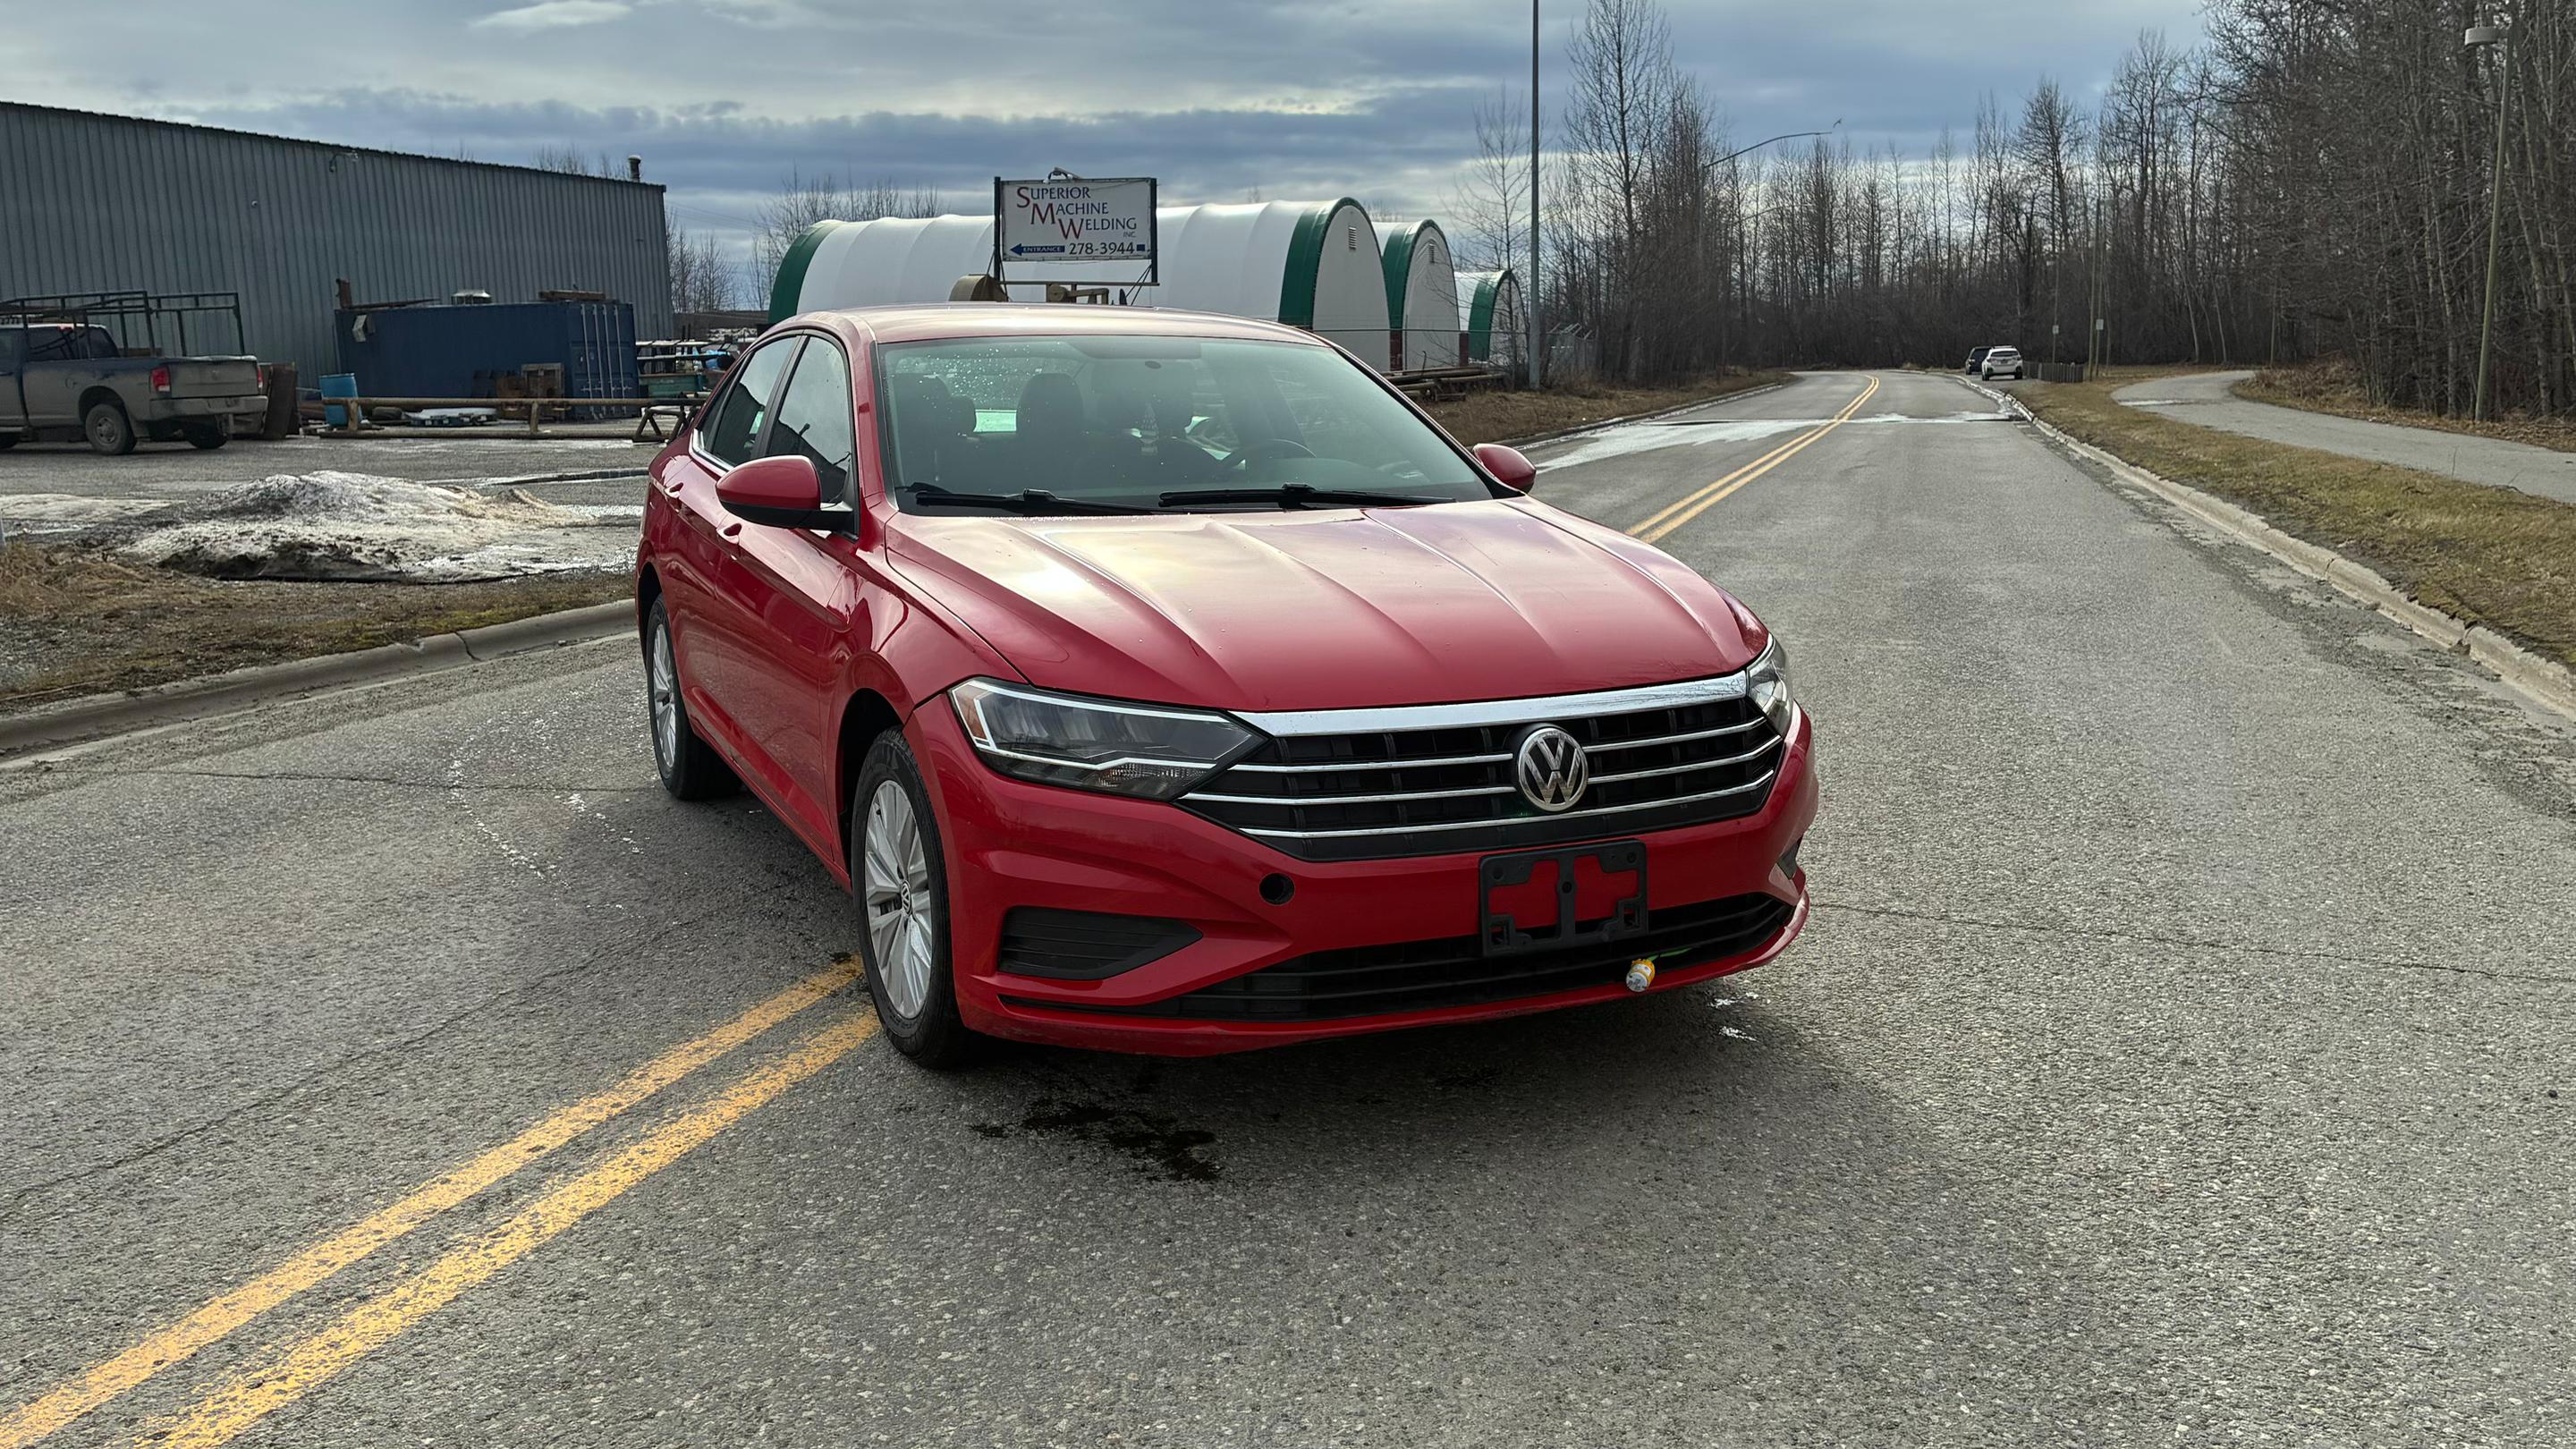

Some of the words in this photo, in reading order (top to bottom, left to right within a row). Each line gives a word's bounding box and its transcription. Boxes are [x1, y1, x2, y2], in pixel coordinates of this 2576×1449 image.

[1017, 186, 1091, 208] SUPERIOR
[1030, 202, 1109, 225] MACHINE
[1058, 217, 1137, 240] WELDING
[1069, 242, 1134, 255] 278-3944
[1521, 732, 1586, 807] VW
